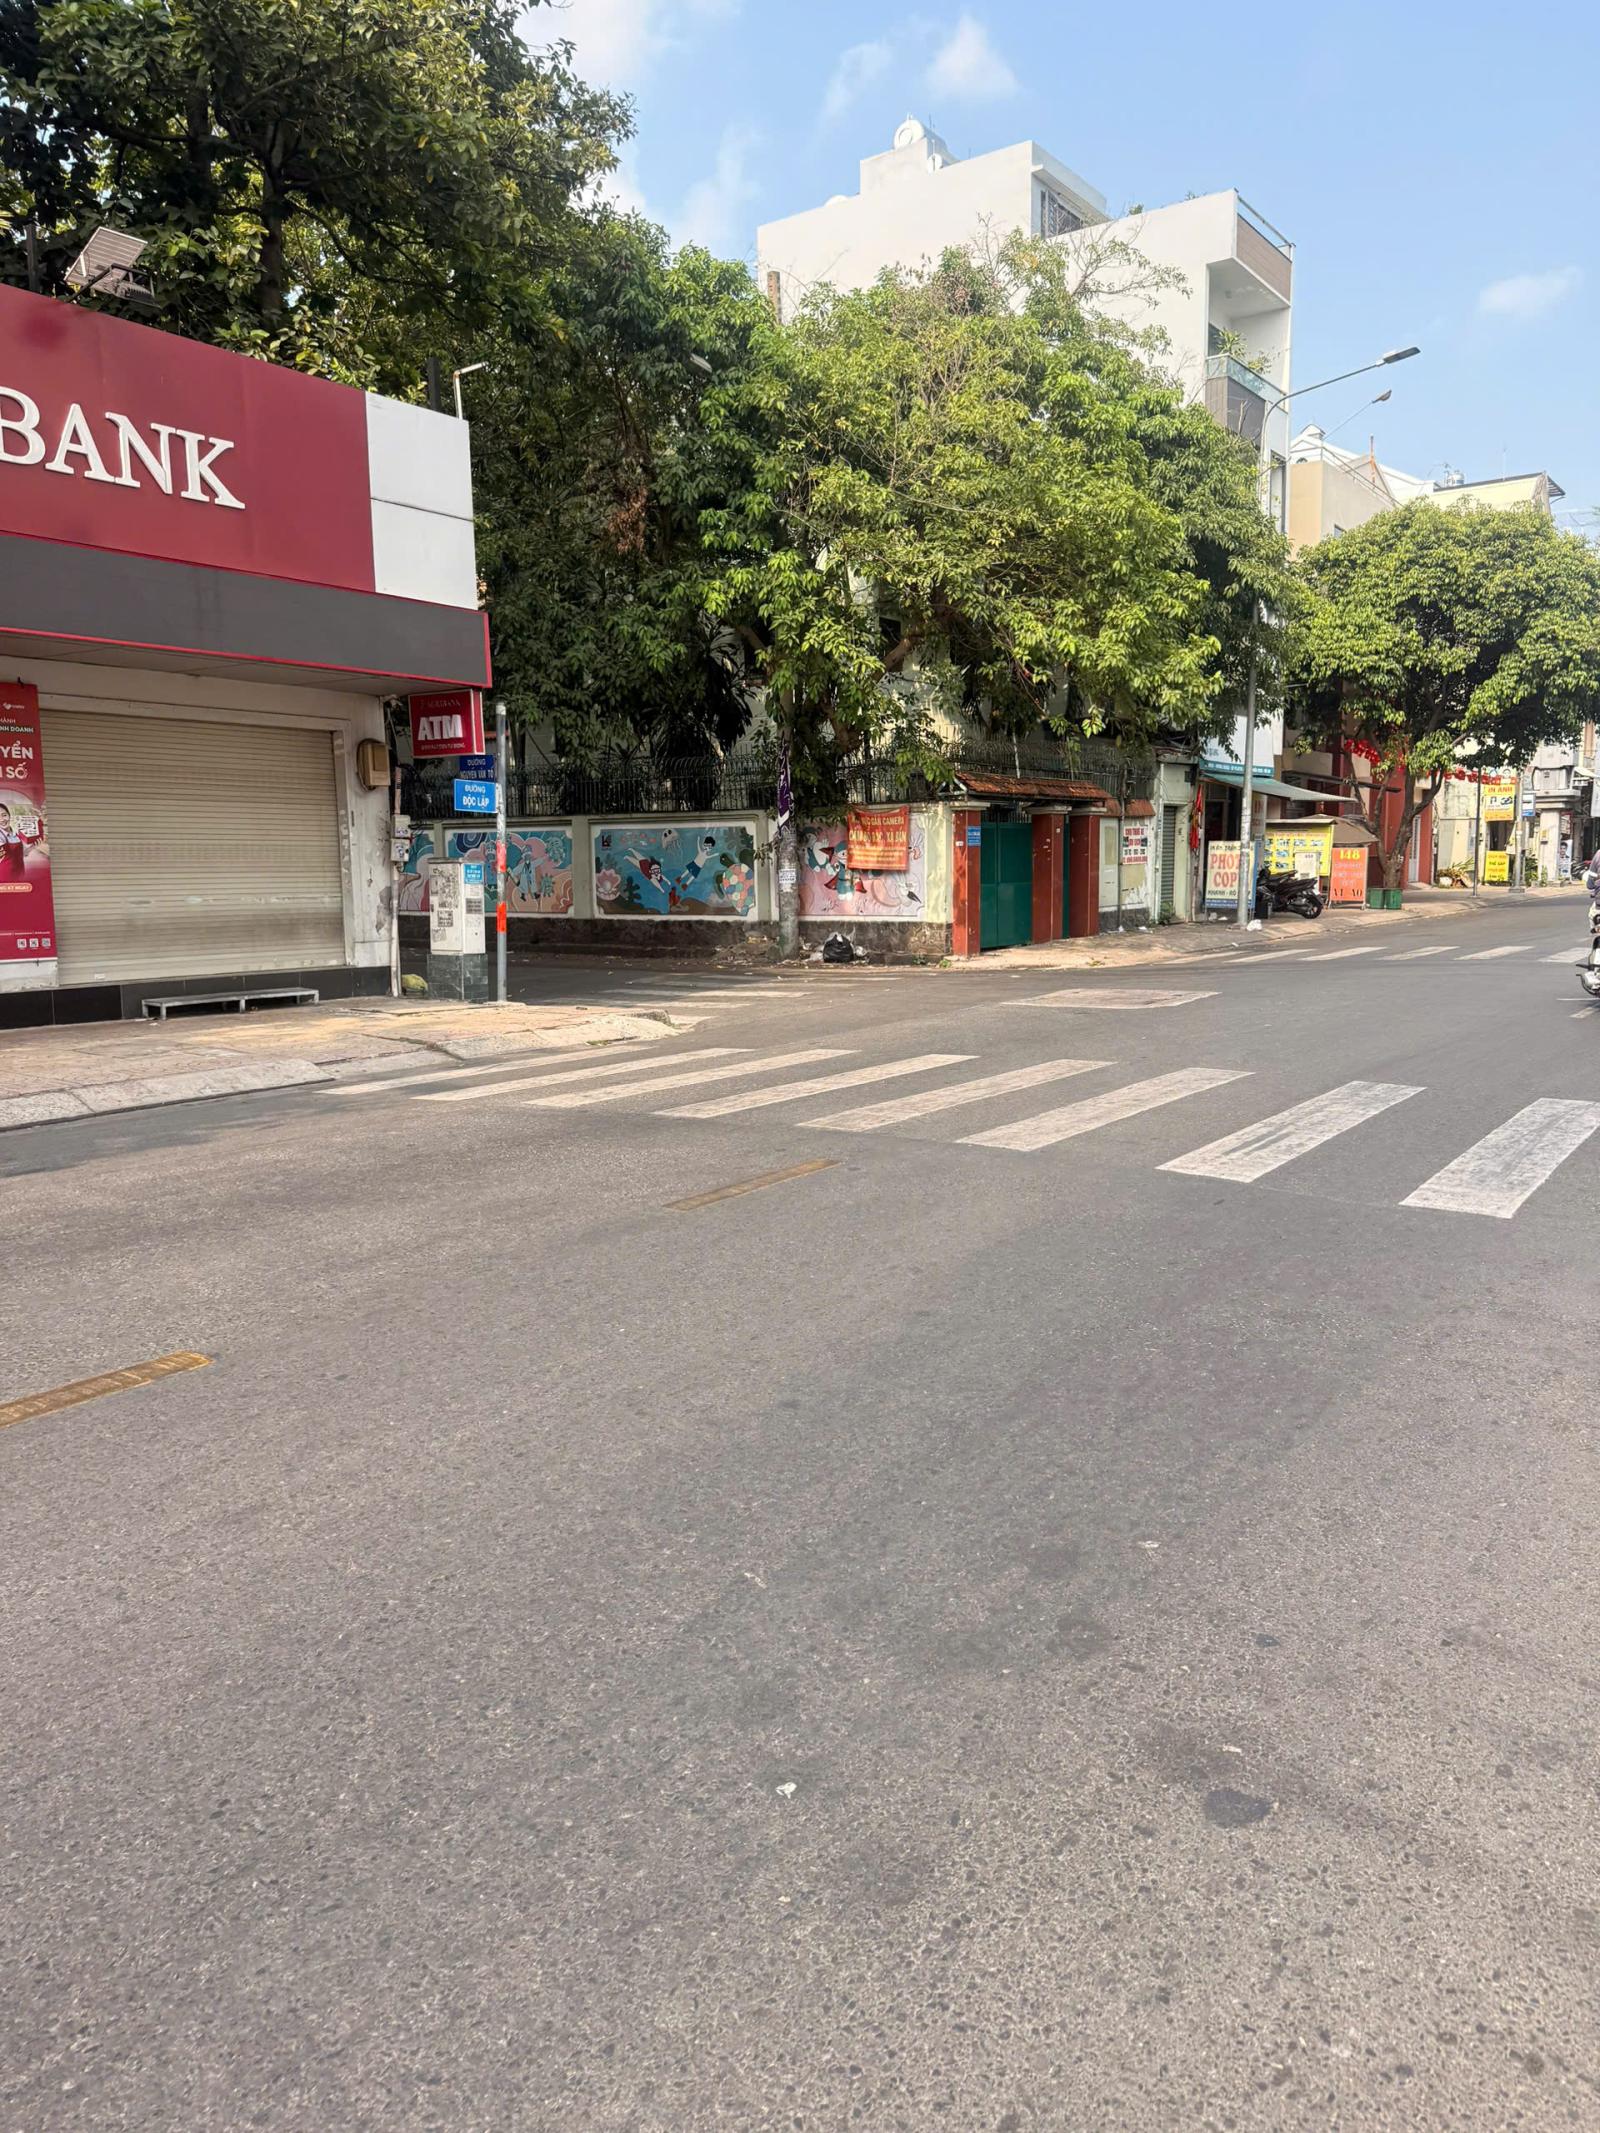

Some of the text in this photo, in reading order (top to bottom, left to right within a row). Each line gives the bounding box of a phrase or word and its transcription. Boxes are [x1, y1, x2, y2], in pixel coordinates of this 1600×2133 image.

[0, 385, 246, 509] BANK
[10, 726, 34, 734] DOANH
[417, 713, 464, 741] ATM
[6, 762, 28, 780] SỐ
[464, 783, 486, 794] ĐƯỜNG
[463, 793, 490, 809] ĐỘC LẬP
[1211, 853, 1241, 869] PHOT
[1339, 849, 1361, 861] 148
[1213, 871, 1238, 888] COP
